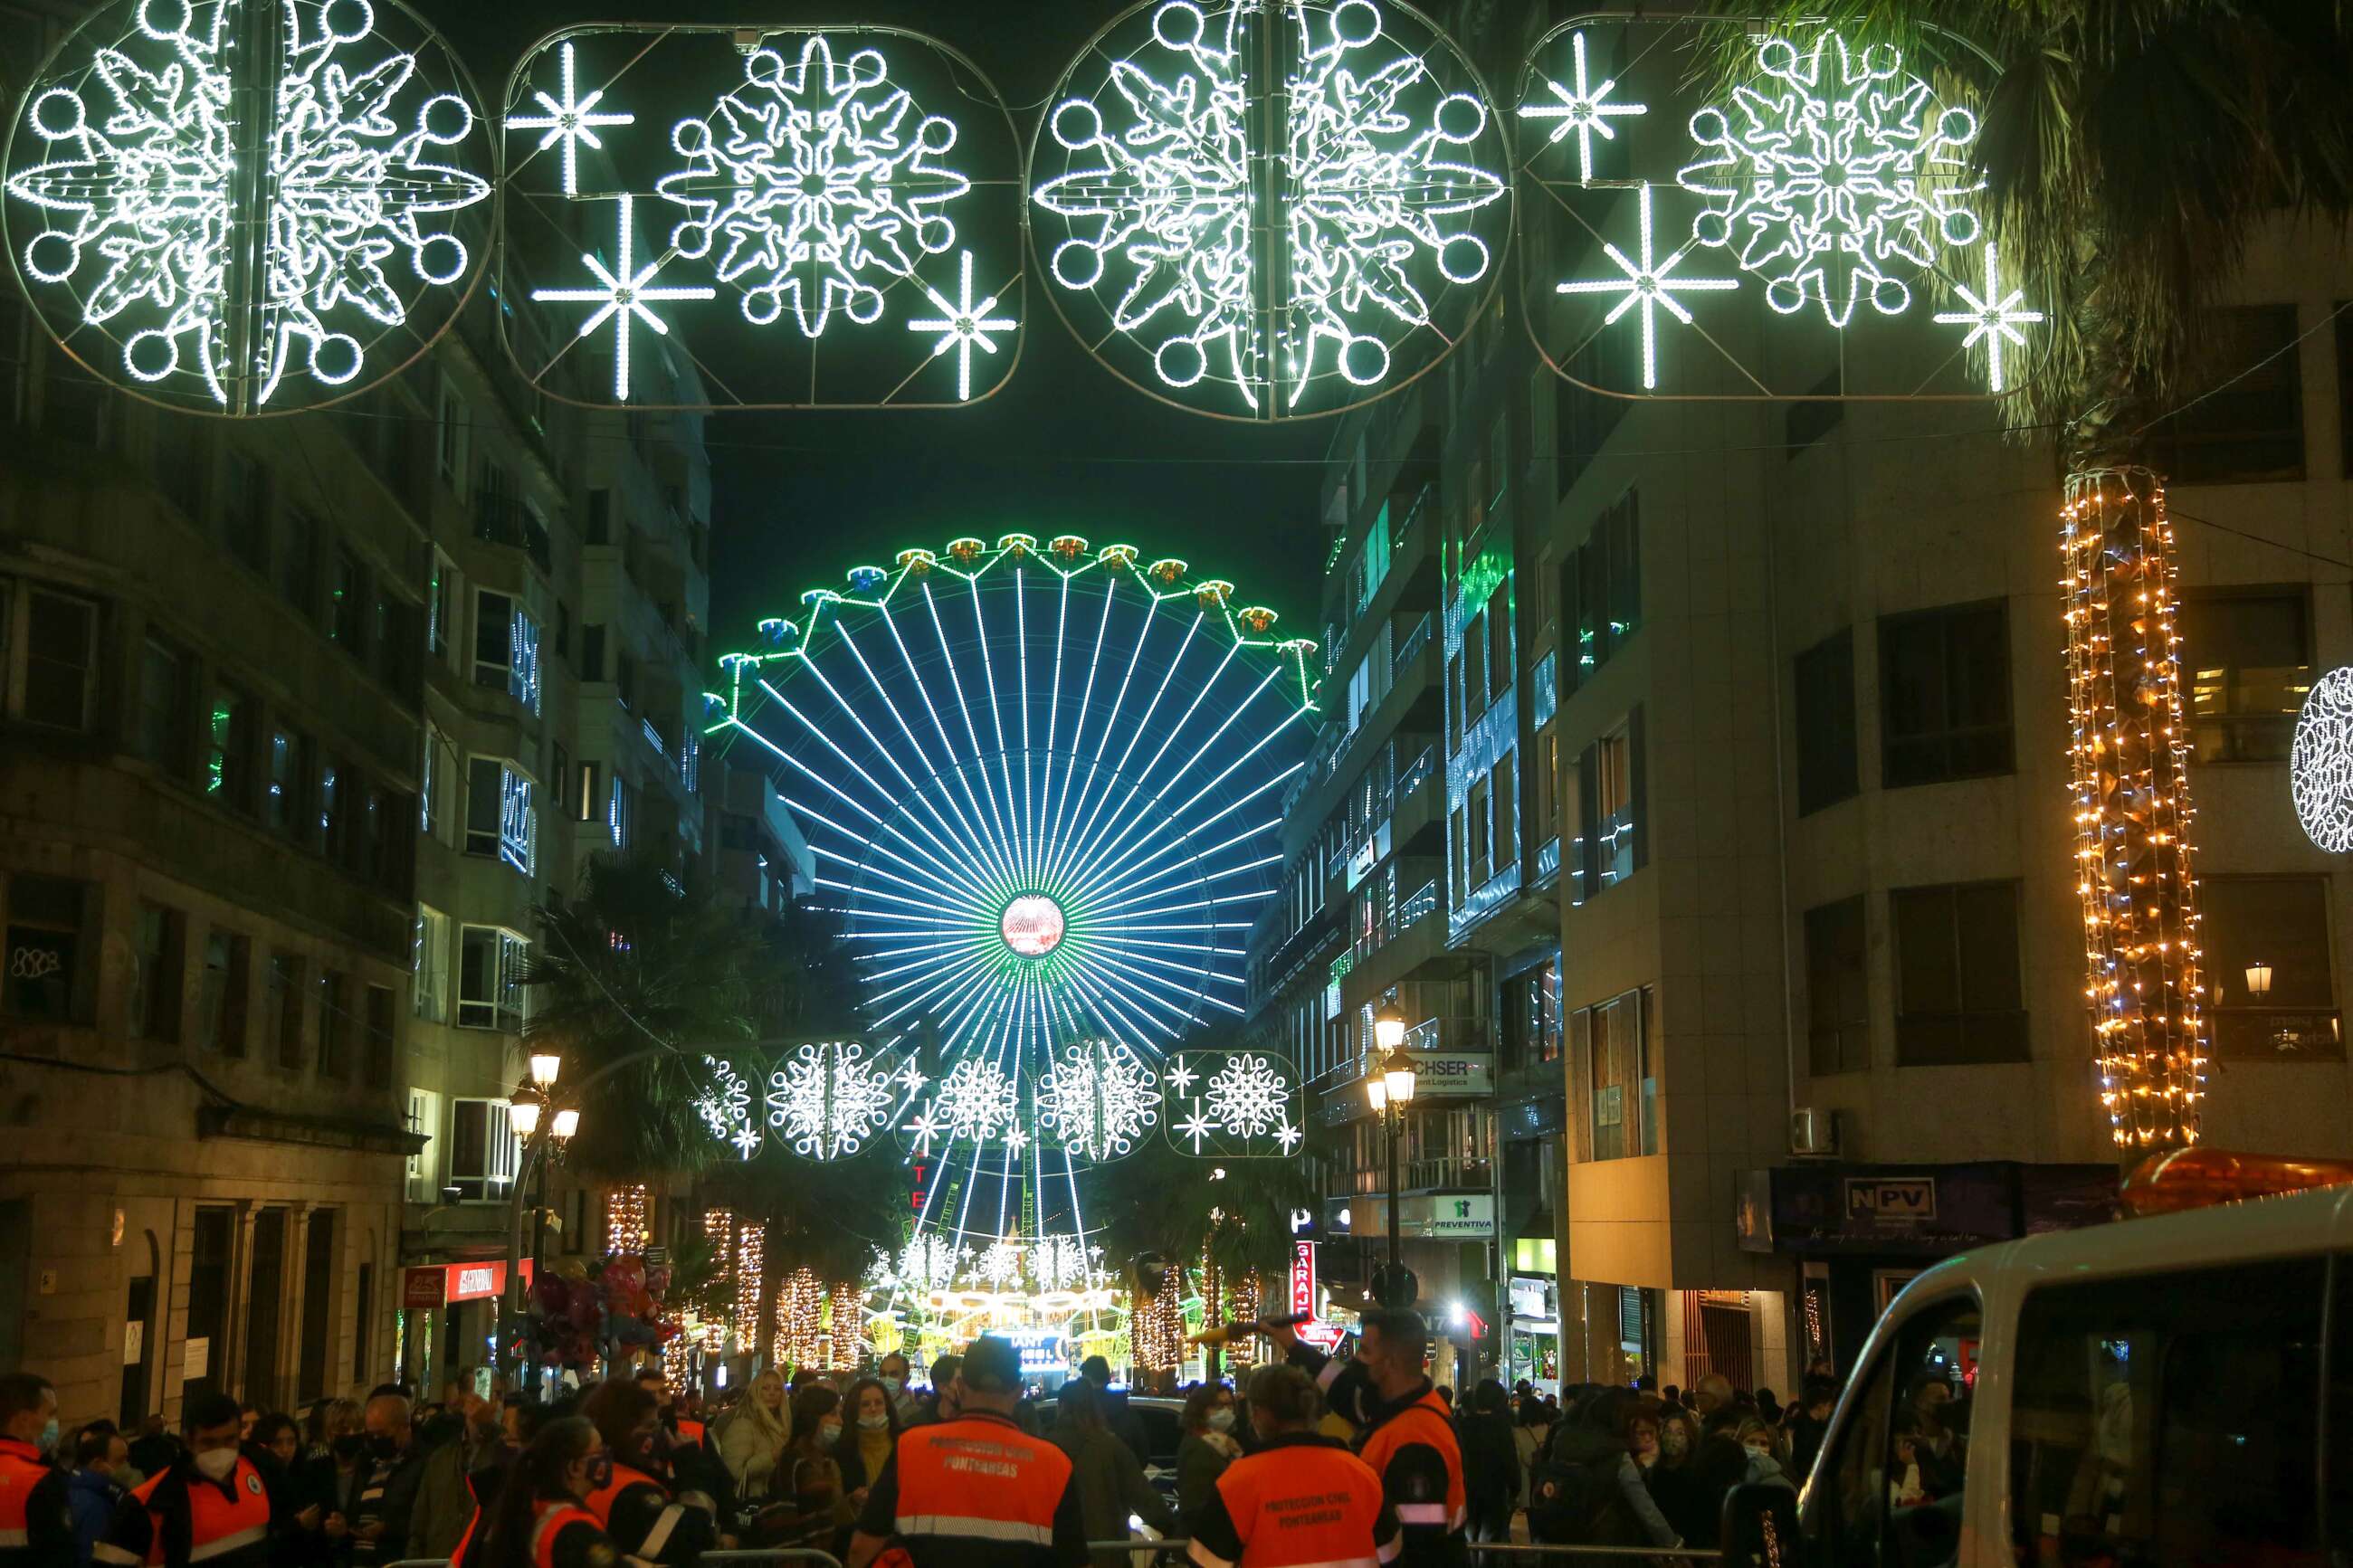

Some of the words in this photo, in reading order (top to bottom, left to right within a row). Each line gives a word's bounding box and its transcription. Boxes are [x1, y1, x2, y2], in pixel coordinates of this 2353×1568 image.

[1415, 1060, 1468, 1075] CHSER
[1432, 1078, 1468, 1087] Logistics
[1852, 1188, 1923, 1208] NPV
[1291, 1207, 1311, 1234] P
